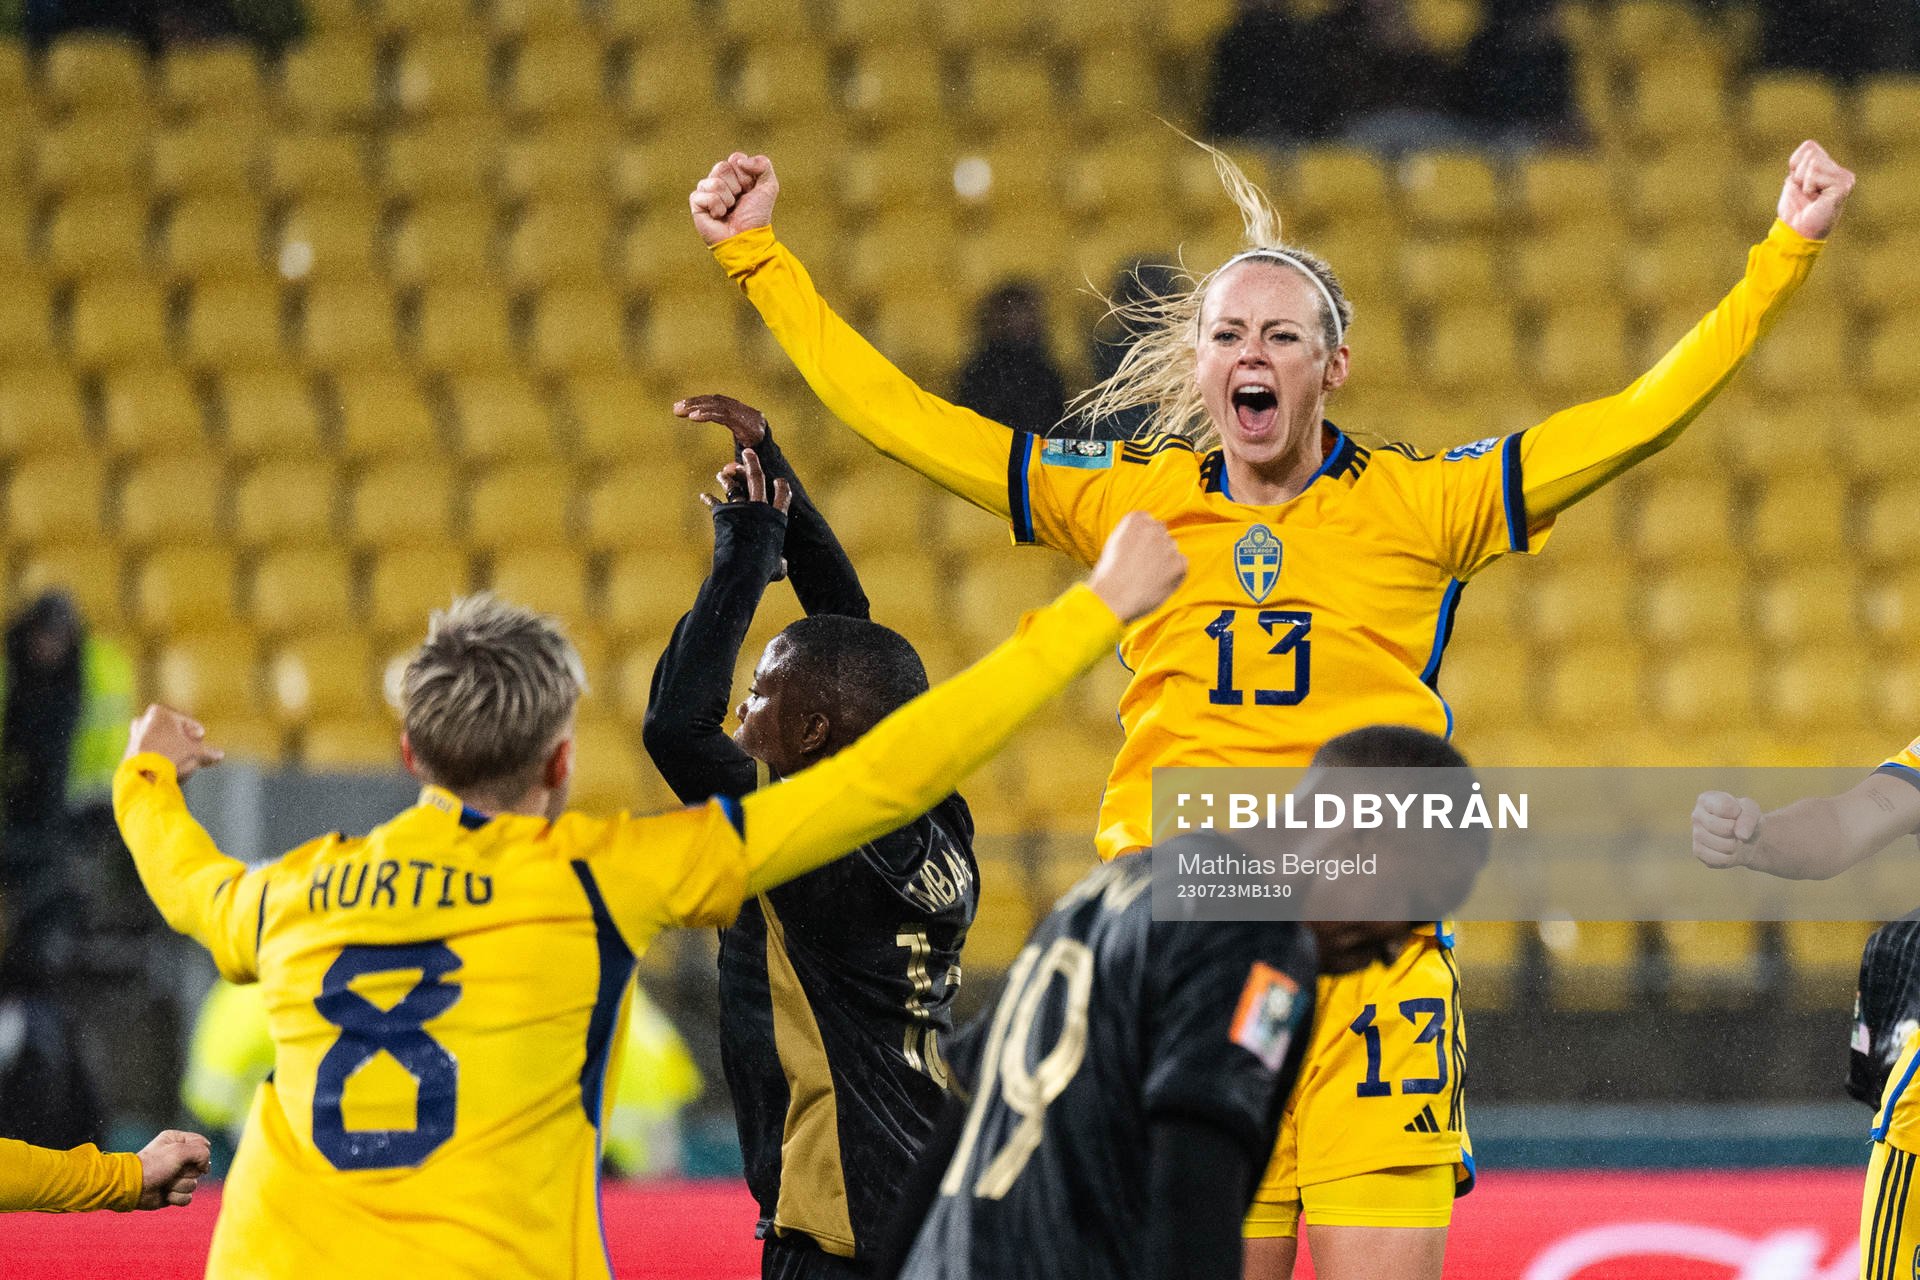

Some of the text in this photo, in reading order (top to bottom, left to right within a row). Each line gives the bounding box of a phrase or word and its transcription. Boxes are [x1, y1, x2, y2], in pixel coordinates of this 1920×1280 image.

[1204, 609, 1312, 706] 13
[312, 940, 463, 1170] 8
[939, 937, 1095, 1200] 19
[1350, 998, 1448, 1098] 13
